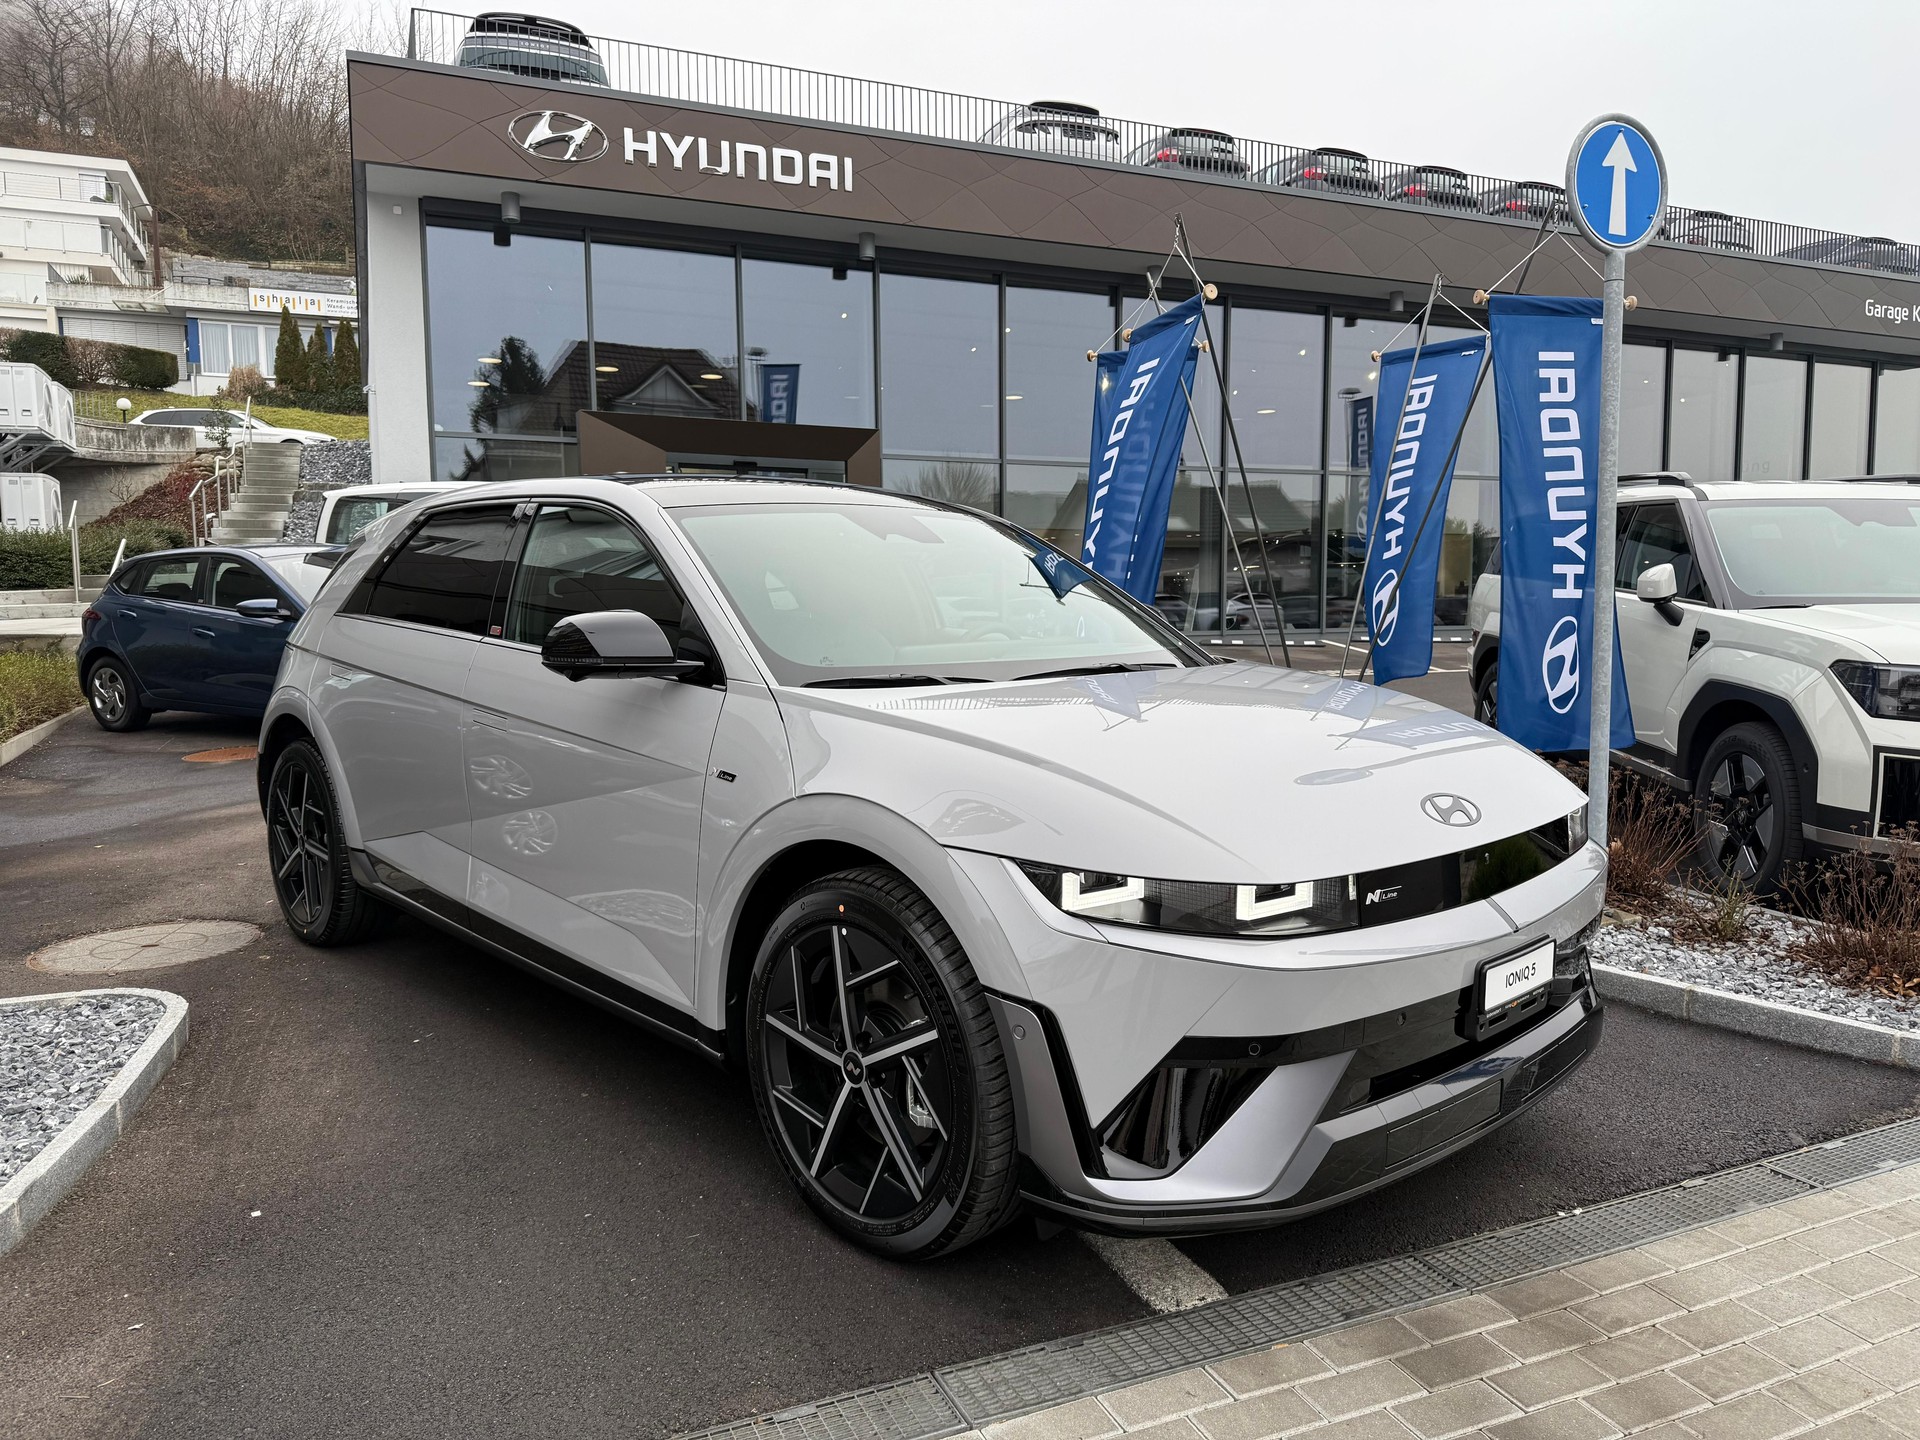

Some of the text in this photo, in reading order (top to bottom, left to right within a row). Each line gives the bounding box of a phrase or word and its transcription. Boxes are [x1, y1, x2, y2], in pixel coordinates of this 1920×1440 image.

[623, 127, 853, 192] HYUNDAI
[259, 294, 316, 306] shala
[1865, 299, 1909, 324] Garage
[1505, 962, 1537, 988] IONIQ 5
